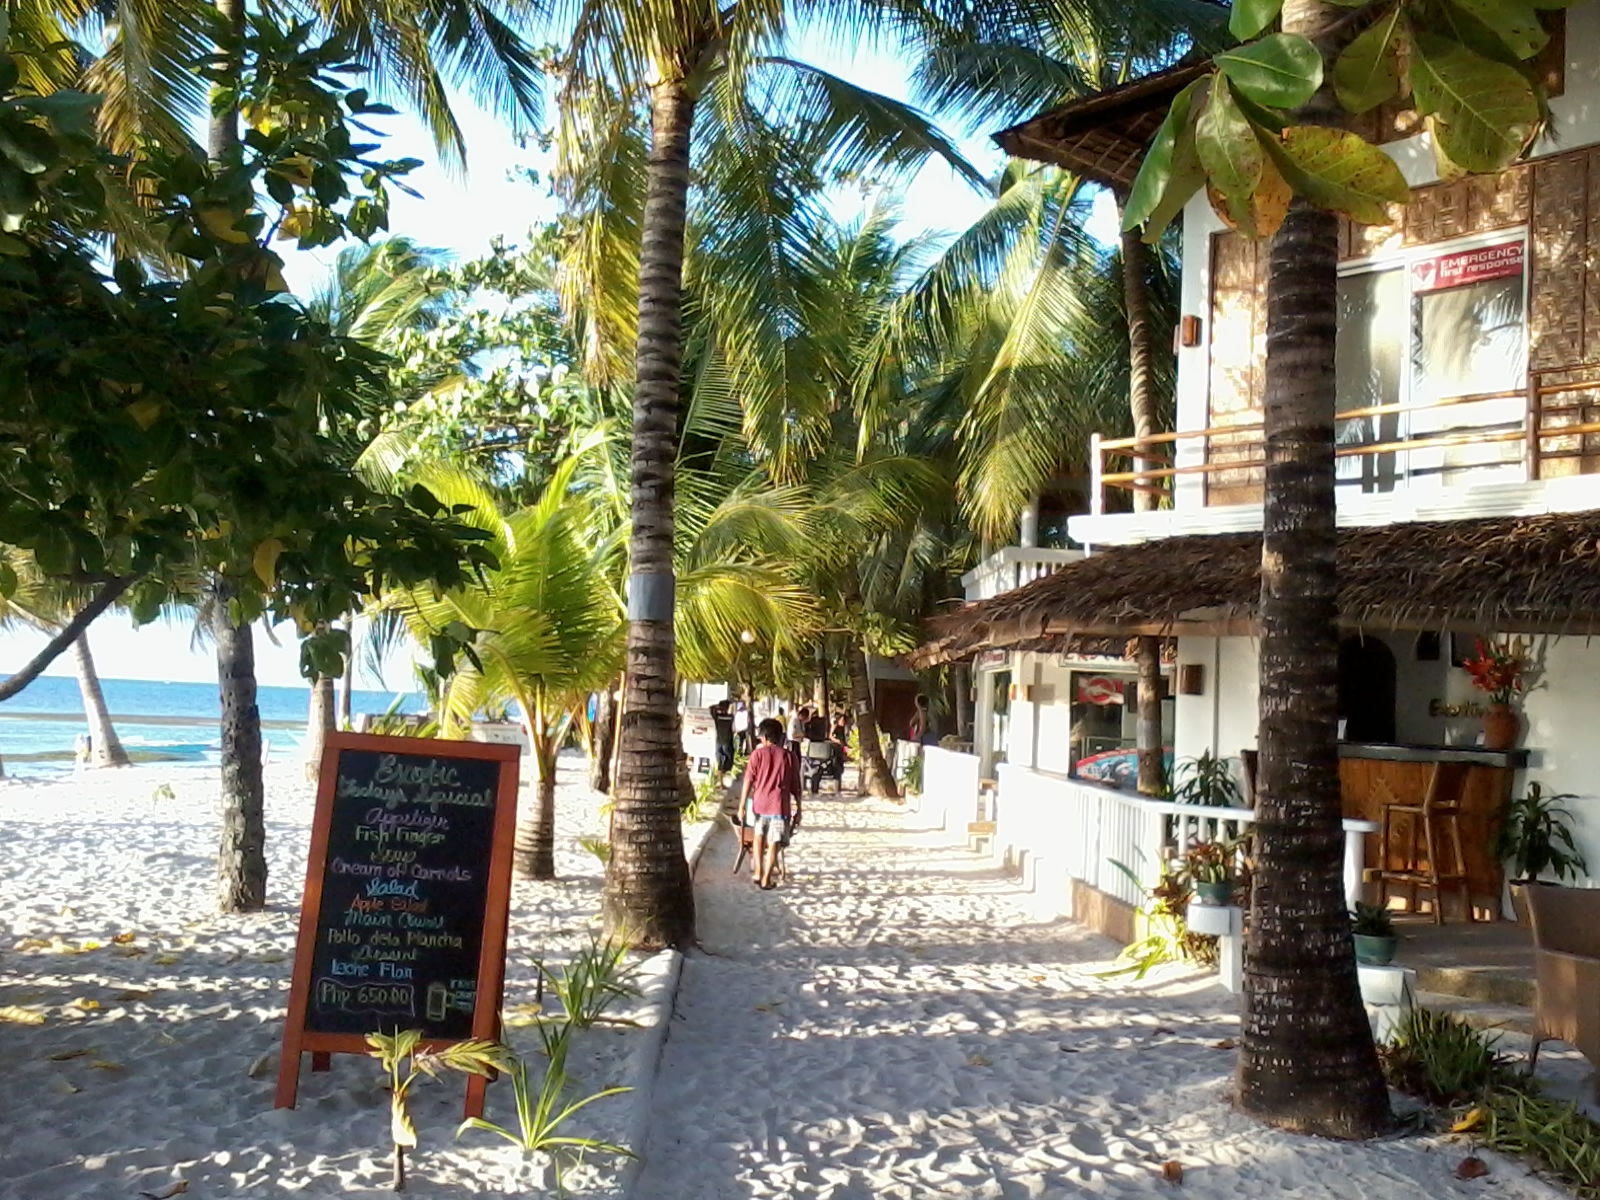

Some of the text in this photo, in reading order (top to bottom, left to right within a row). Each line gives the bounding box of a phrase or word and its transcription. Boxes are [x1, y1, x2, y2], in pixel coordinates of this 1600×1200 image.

[1440, 245, 1524, 269] EMERGENCY
[1440, 266, 1463, 278] first
[1467, 256, 1524, 272] response
[375, 754, 461, 787] Exotic
[355, 824, 446, 848] Fish Finger
[331, 857, 382, 875] Cream
[387, 862, 407, 879] of
[366, 877, 419, 900] Salad
[351, 894, 428, 913] Apple Salad
[344, 910, 392, 926] Main
[328, 928, 360, 945] Pollo
[407, 931, 463, 949] Plancha
[380, 961, 413, 979] Flan
